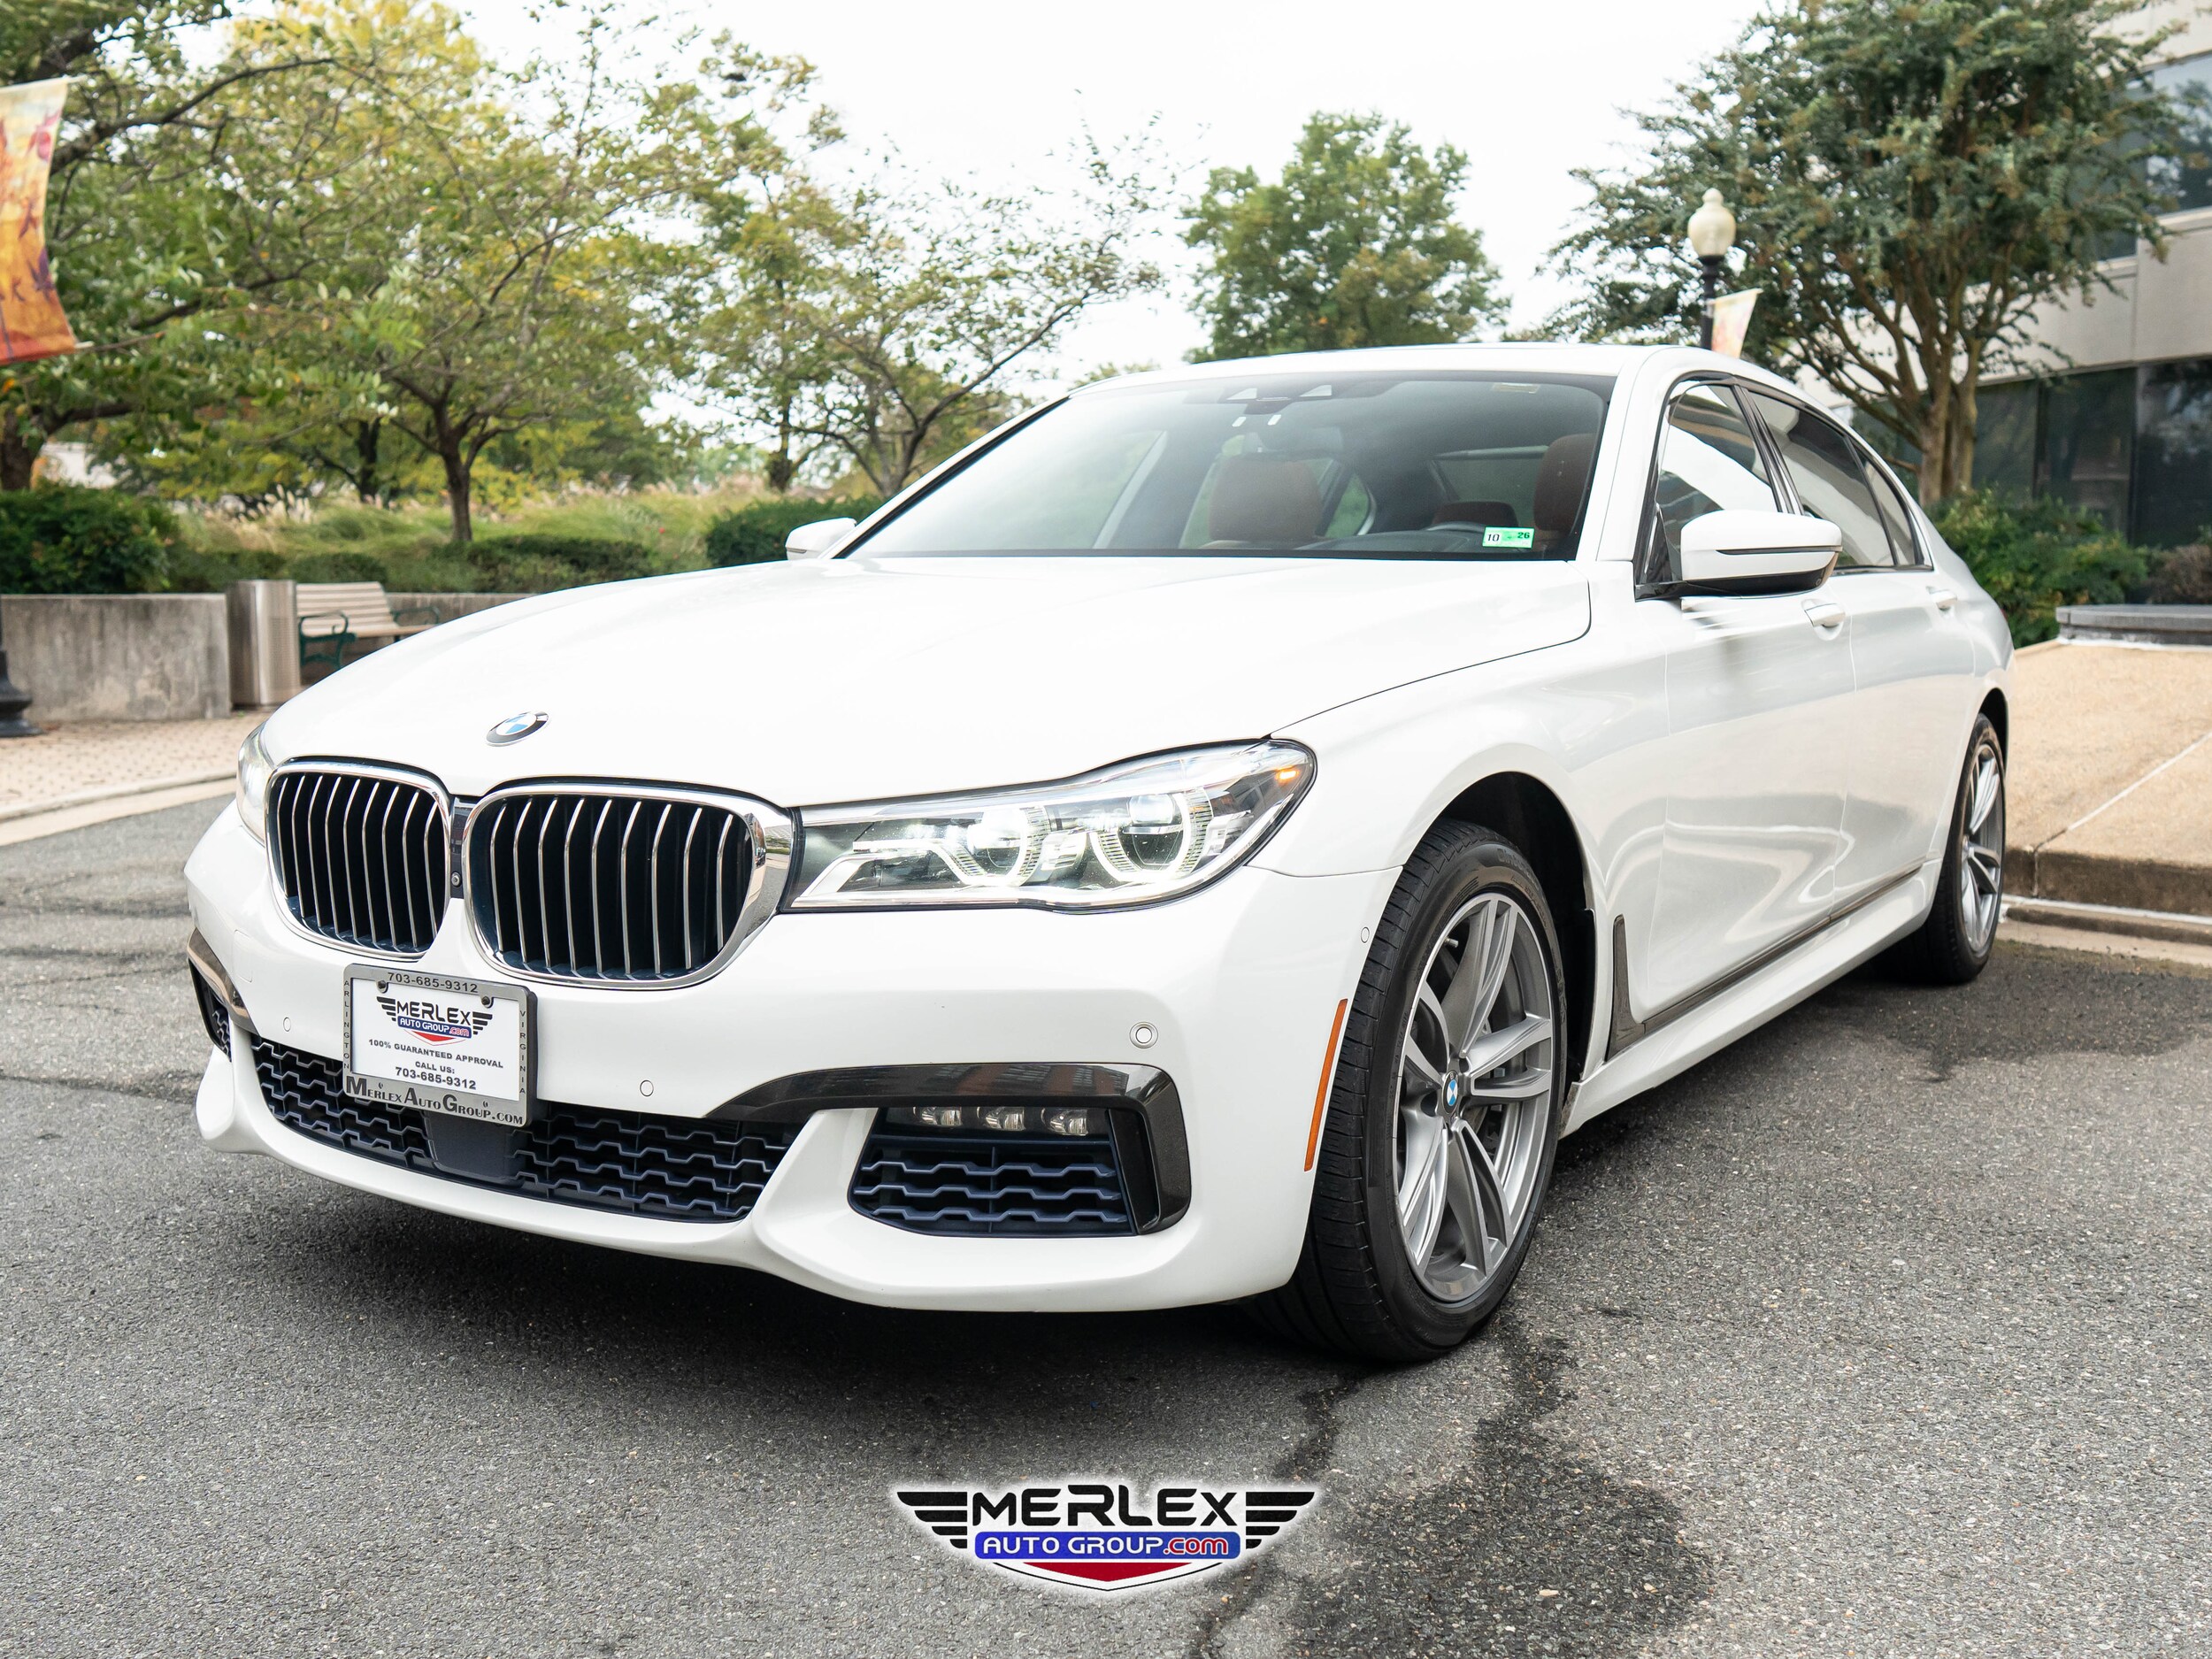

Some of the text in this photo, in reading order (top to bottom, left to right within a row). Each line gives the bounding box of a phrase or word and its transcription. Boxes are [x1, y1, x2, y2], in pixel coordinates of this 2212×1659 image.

[388, 972, 479, 994] 703-685-9312
[396, 1001, 472, 1026] MERLEX
[400, 1018, 421, 1028] AUTO
[368, 1039, 503, 1069] 100% GUARANTEED APPROVAL
[395, 1066, 477, 1091] 703-685-9312
[415, 1061, 456, 1074] CALL US:
